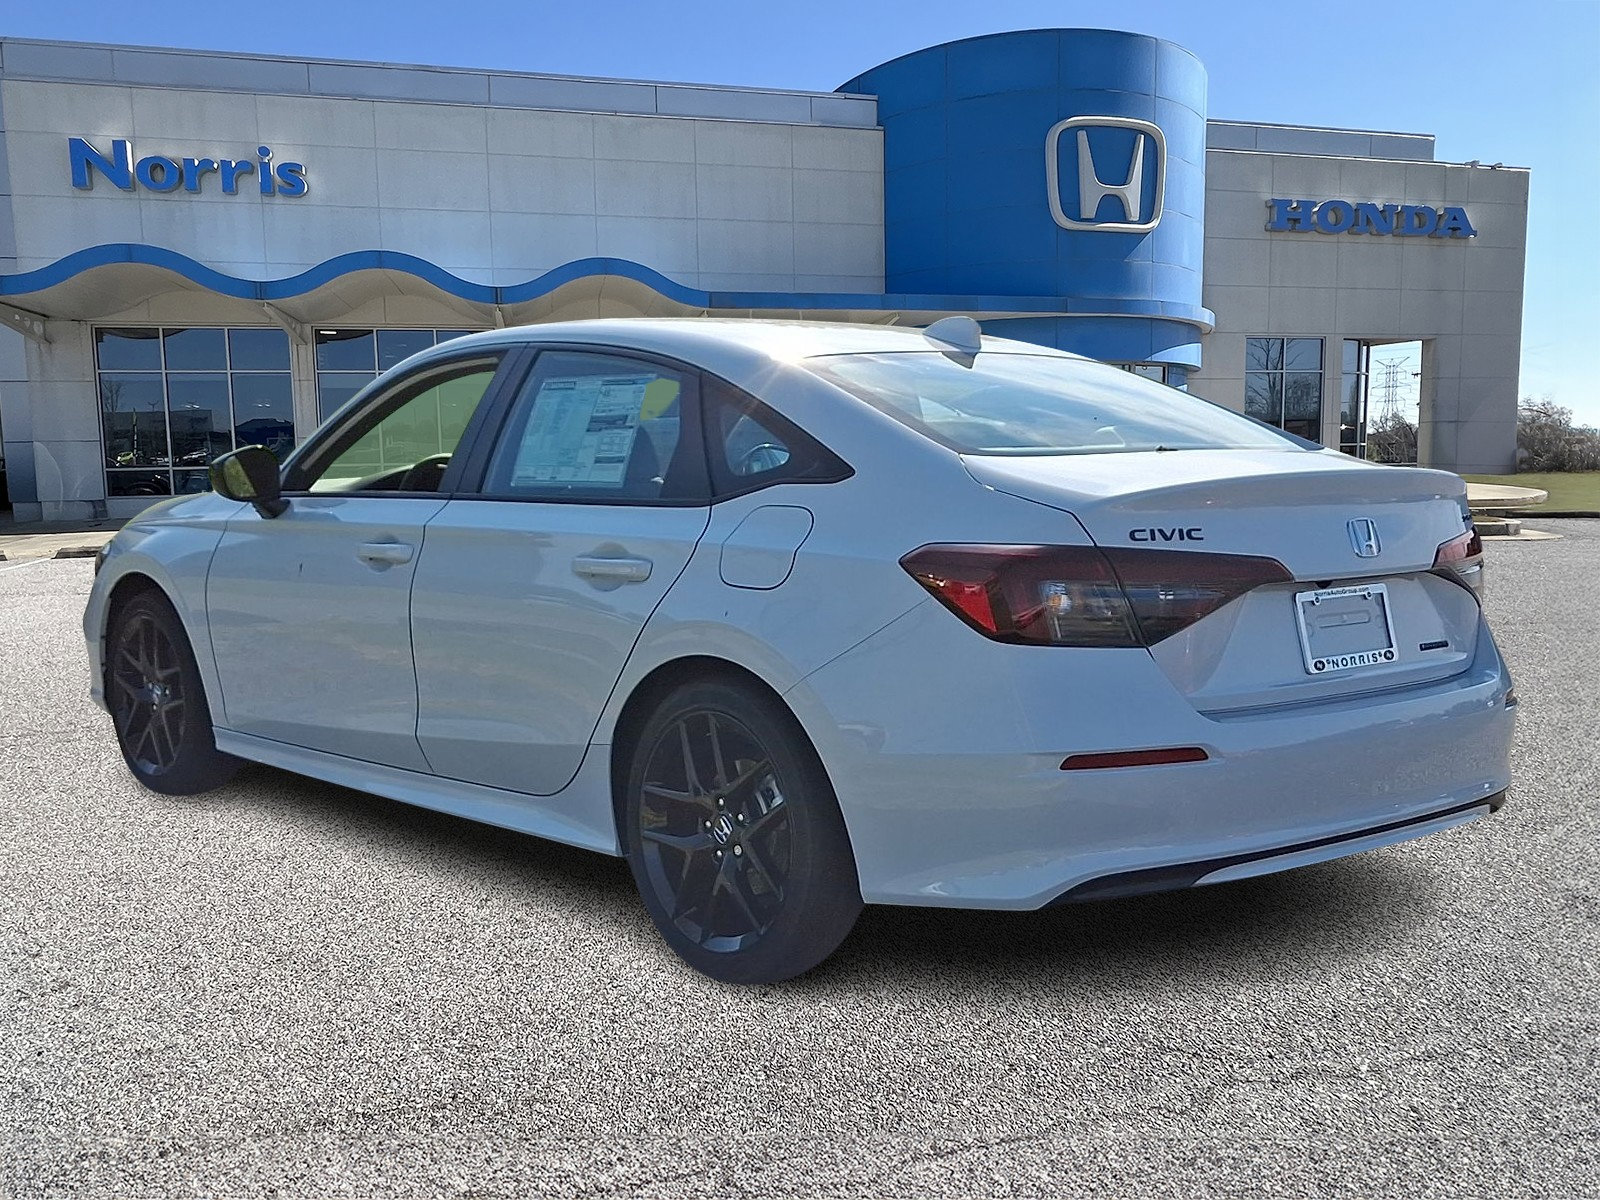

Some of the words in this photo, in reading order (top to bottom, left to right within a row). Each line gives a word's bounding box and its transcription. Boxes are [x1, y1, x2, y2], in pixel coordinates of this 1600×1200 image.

[68, 137, 308, 198] Norris
[1265, 198, 1477, 239] HONDA
[1129, 528, 1204, 541] CIVIC
[1313, 586, 1370, 597] NorrisAutoGroup.com
[1332, 652, 1378, 669] NORRIS
